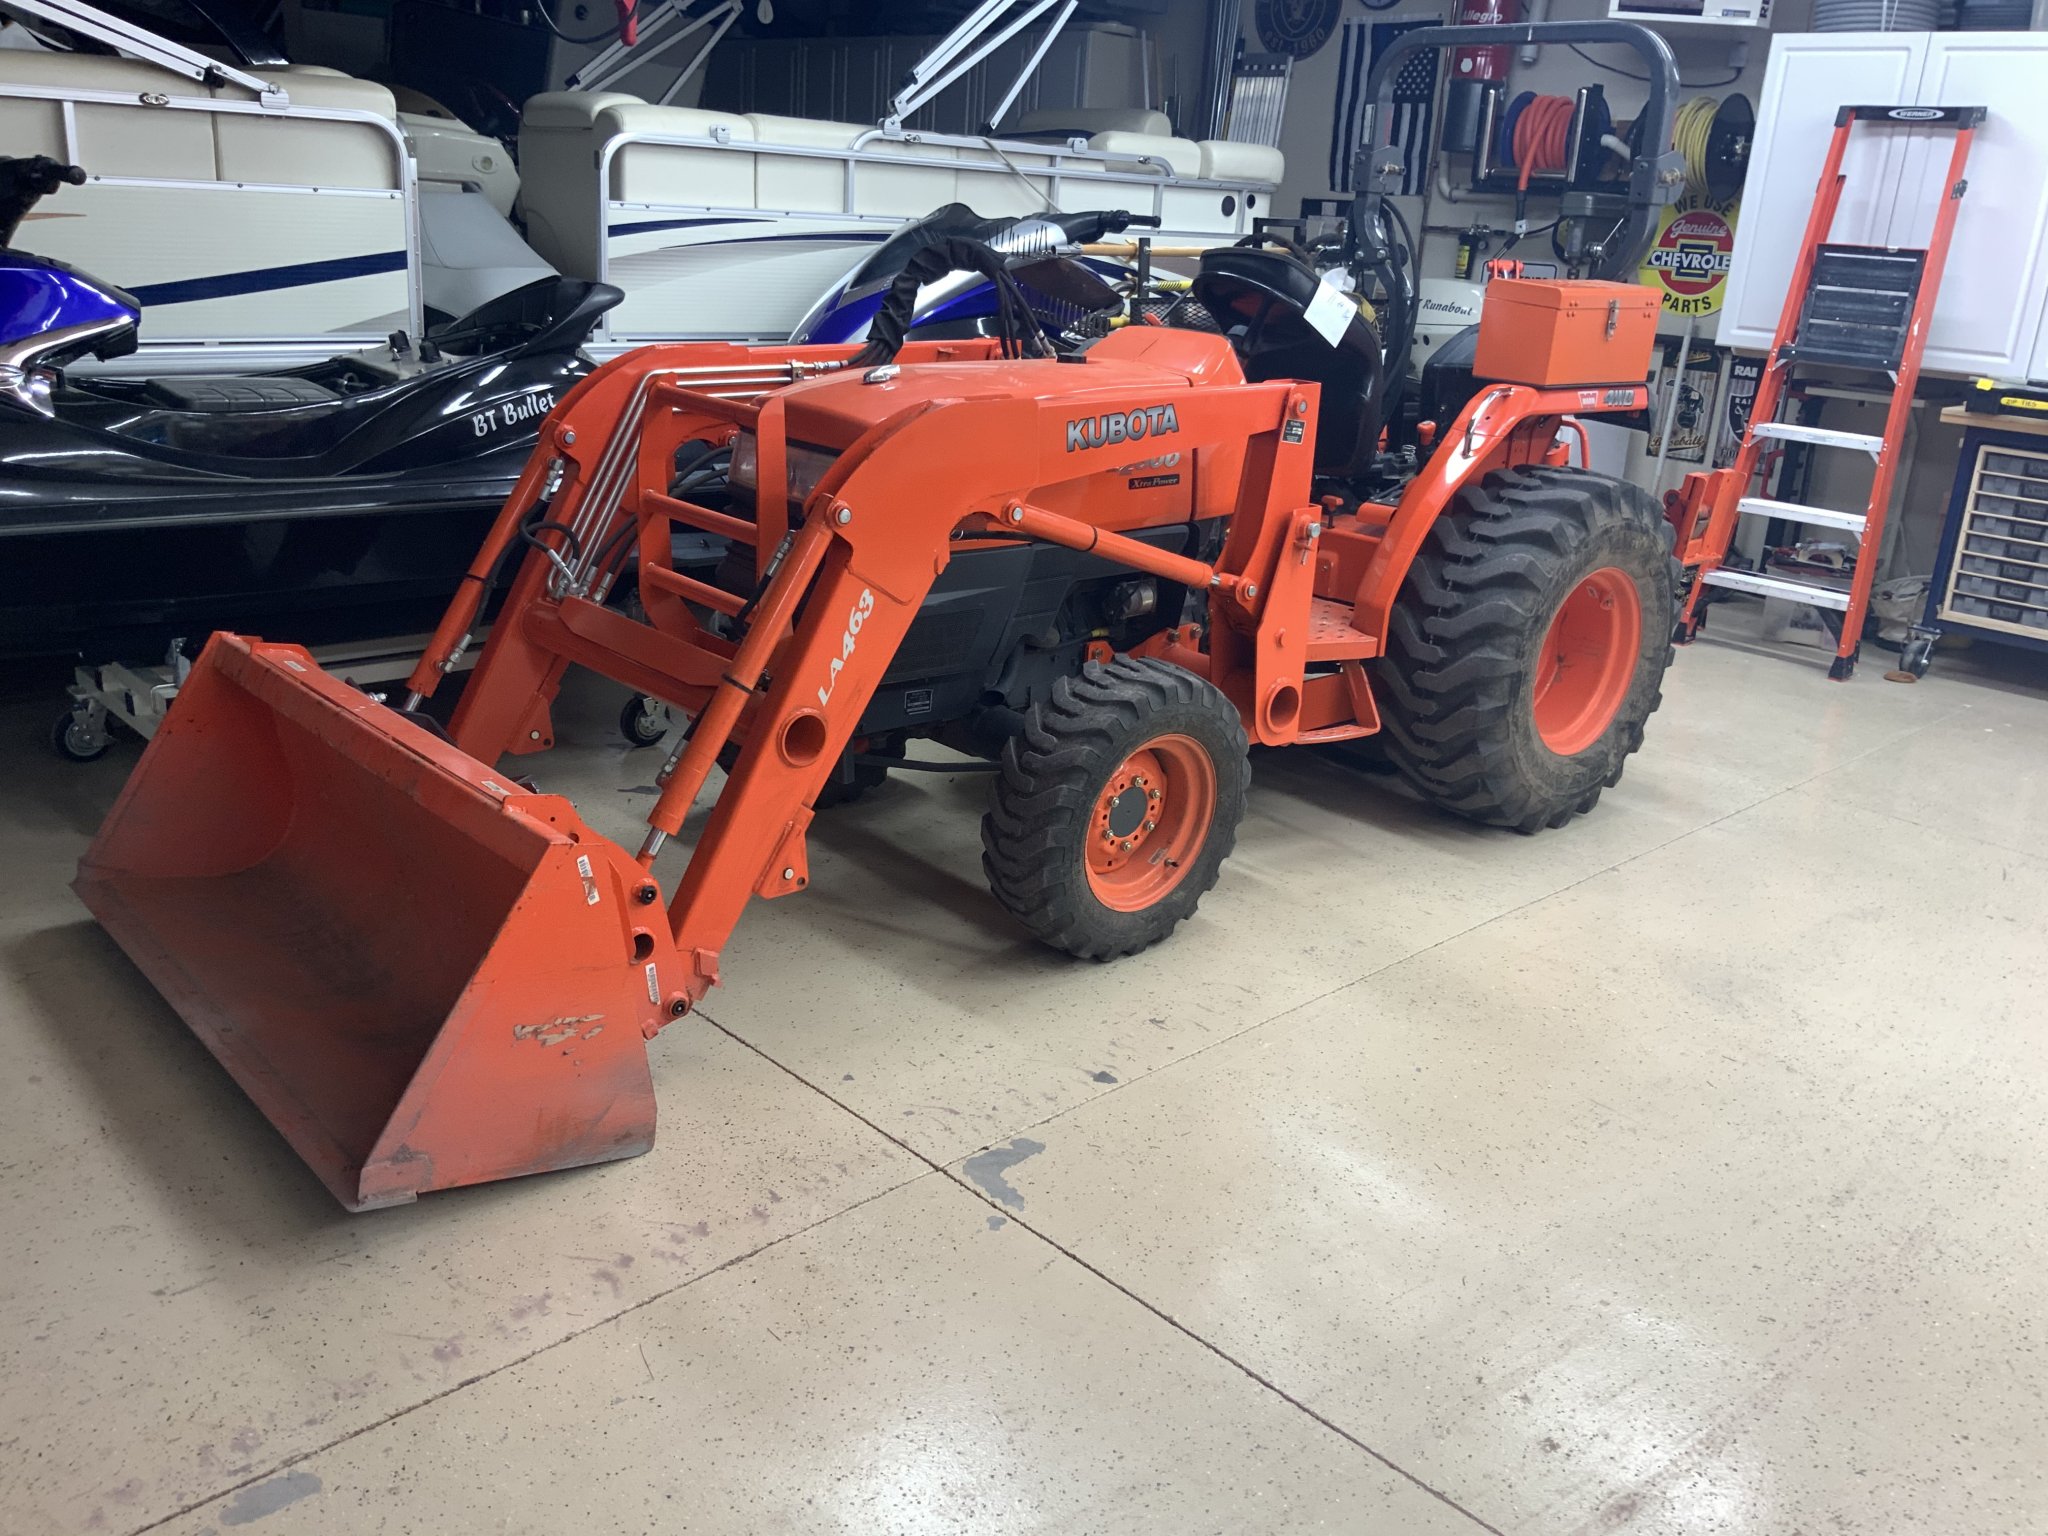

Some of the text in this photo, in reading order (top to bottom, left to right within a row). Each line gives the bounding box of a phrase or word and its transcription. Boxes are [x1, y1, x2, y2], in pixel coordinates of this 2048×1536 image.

[1674, 195, 1734, 218] WE USE
[1670, 219, 1728, 239] Genuine
[1650, 251, 1731, 270] CHEVROLE
[1422, 300, 1473, 316] Runabout
[1661, 293, 1712, 314] PARTS
[1604, 389, 1635, 406] 4WD
[472, 392, 557, 437] BT Bullet
[1066, 403, 1179, 453] KUBOTA
[817, 588, 875, 707] LA463
